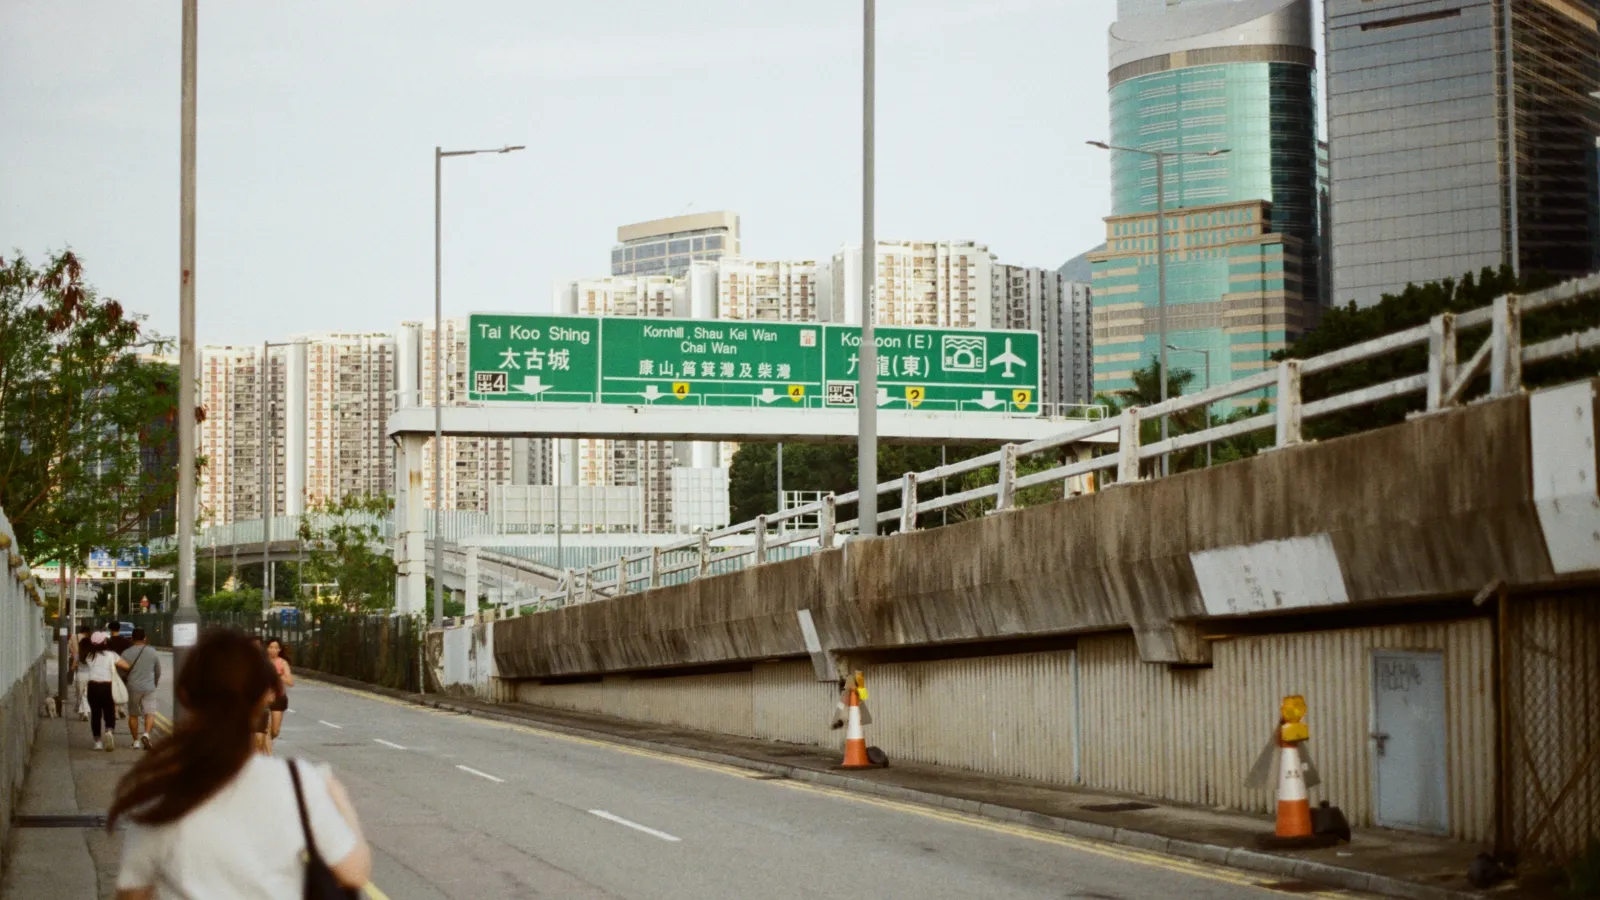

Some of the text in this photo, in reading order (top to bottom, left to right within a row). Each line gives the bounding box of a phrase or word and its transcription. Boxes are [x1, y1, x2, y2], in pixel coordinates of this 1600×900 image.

[478, 324, 590, 345] Tai Koo Shing
[694, 327, 723, 340] Shau
[730, 328, 747, 341] Kei
[753, 329, 777, 342] Wan
[841, 332, 932, 349] Kooon (E)
[680, 341, 737, 355] Chai Wan
[498, 347, 570, 371] 太古城
[976, 357, 982, 368] E
[493, 374, 505, 391] 4
[677, 385, 686, 394] 4
[792, 388, 801, 397] 4
[843, 386, 853, 402] 5
[911, 390, 920, 402] 2
[1018, 393, 1026, 404] 2
